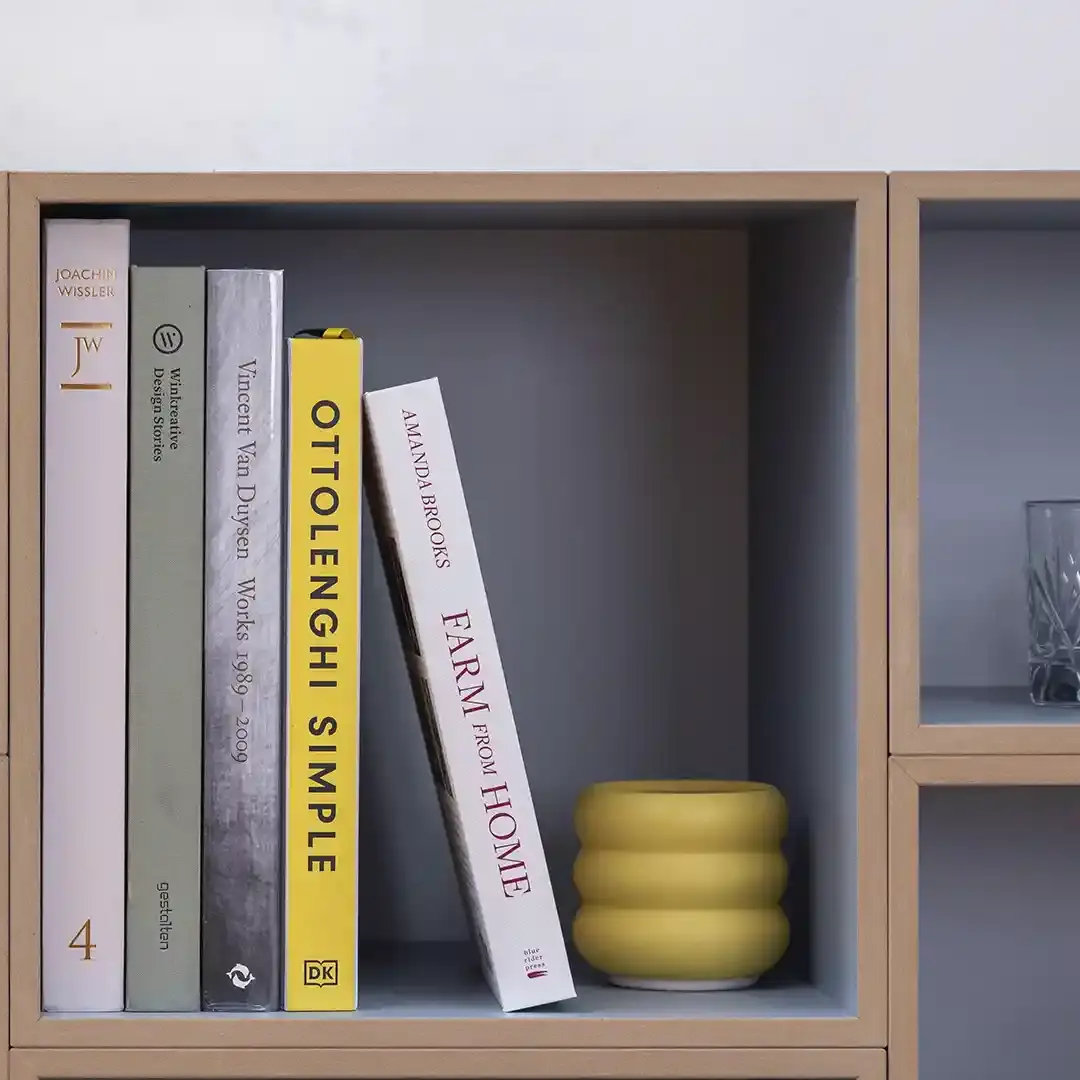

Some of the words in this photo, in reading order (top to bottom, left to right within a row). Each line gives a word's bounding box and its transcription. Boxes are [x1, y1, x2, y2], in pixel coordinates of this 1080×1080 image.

[56, 286, 115, 298] WISSLER
[152, 367, 164, 413] Design
[169, 367, 181, 450] Winkreative
[236, 358, 258, 436] Vincent
[154, 416, 164, 462] Stories
[236, 439, 257, 479] Van
[402, 409, 431, 490] AMANDA
[422, 494, 451, 569] BROOKS
[235, 484, 256, 560] Duysen
[308, 399, 341, 688] OTTOLENGHI
[236, 577, 256, 643] Works
[441, 609, 490, 718] FARM
[472, 723, 497, 775] FROM
[307, 716, 338, 872] SIMPLE
[480, 782, 531, 899] HOME
[69, 918, 97, 961] 4
[156, 882, 173, 950] gestalten
[308, 966, 333, 981] DK
[523, 947, 540, 956] blue
[524, 955, 543, 963] rider
[525, 962, 546, 972] press
